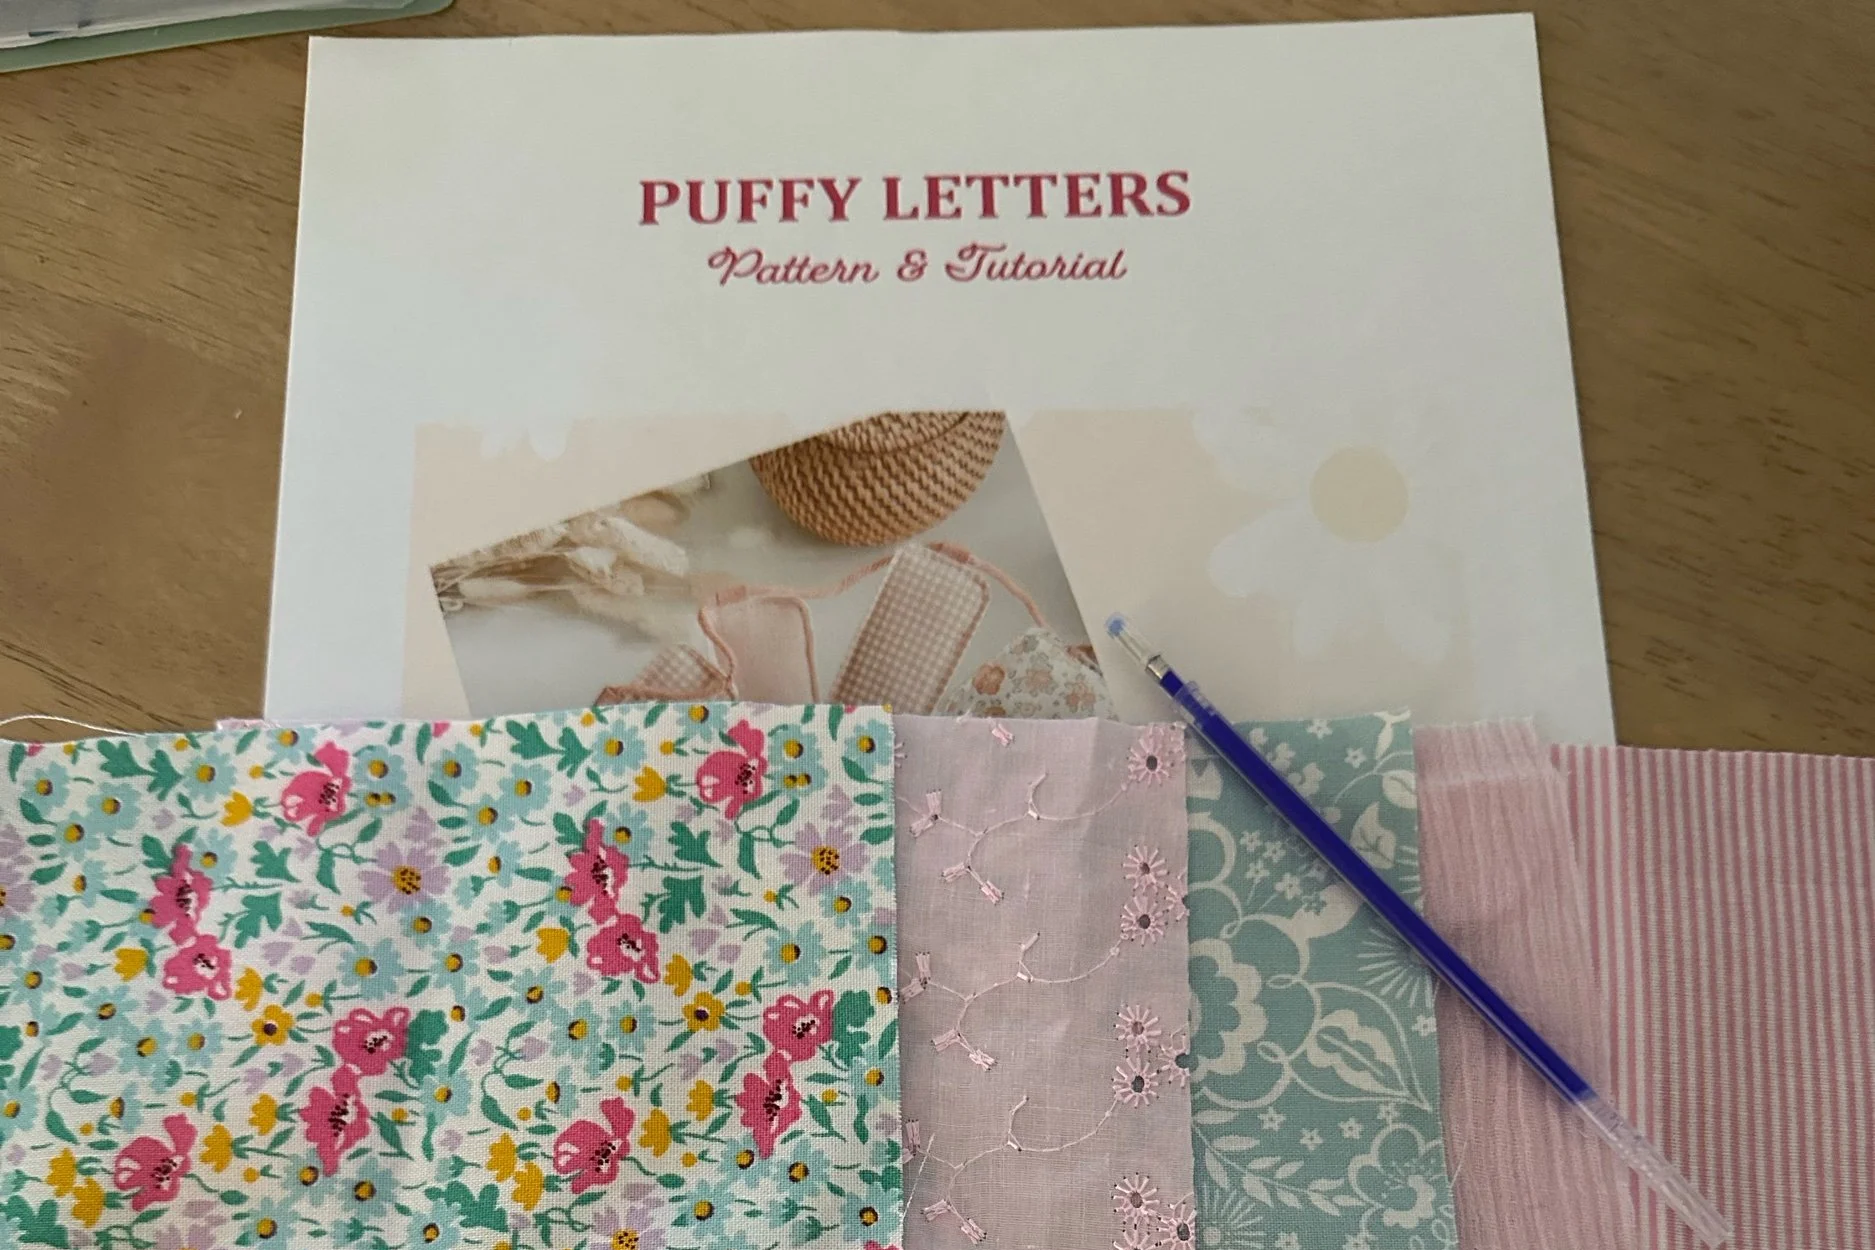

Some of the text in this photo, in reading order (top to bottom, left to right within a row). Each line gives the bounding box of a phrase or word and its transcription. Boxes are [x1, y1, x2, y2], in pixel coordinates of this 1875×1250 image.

[638, 170, 1192, 226] PUFFY LETTERS
[707, 242, 1128, 286] Pattern & Tutorial
